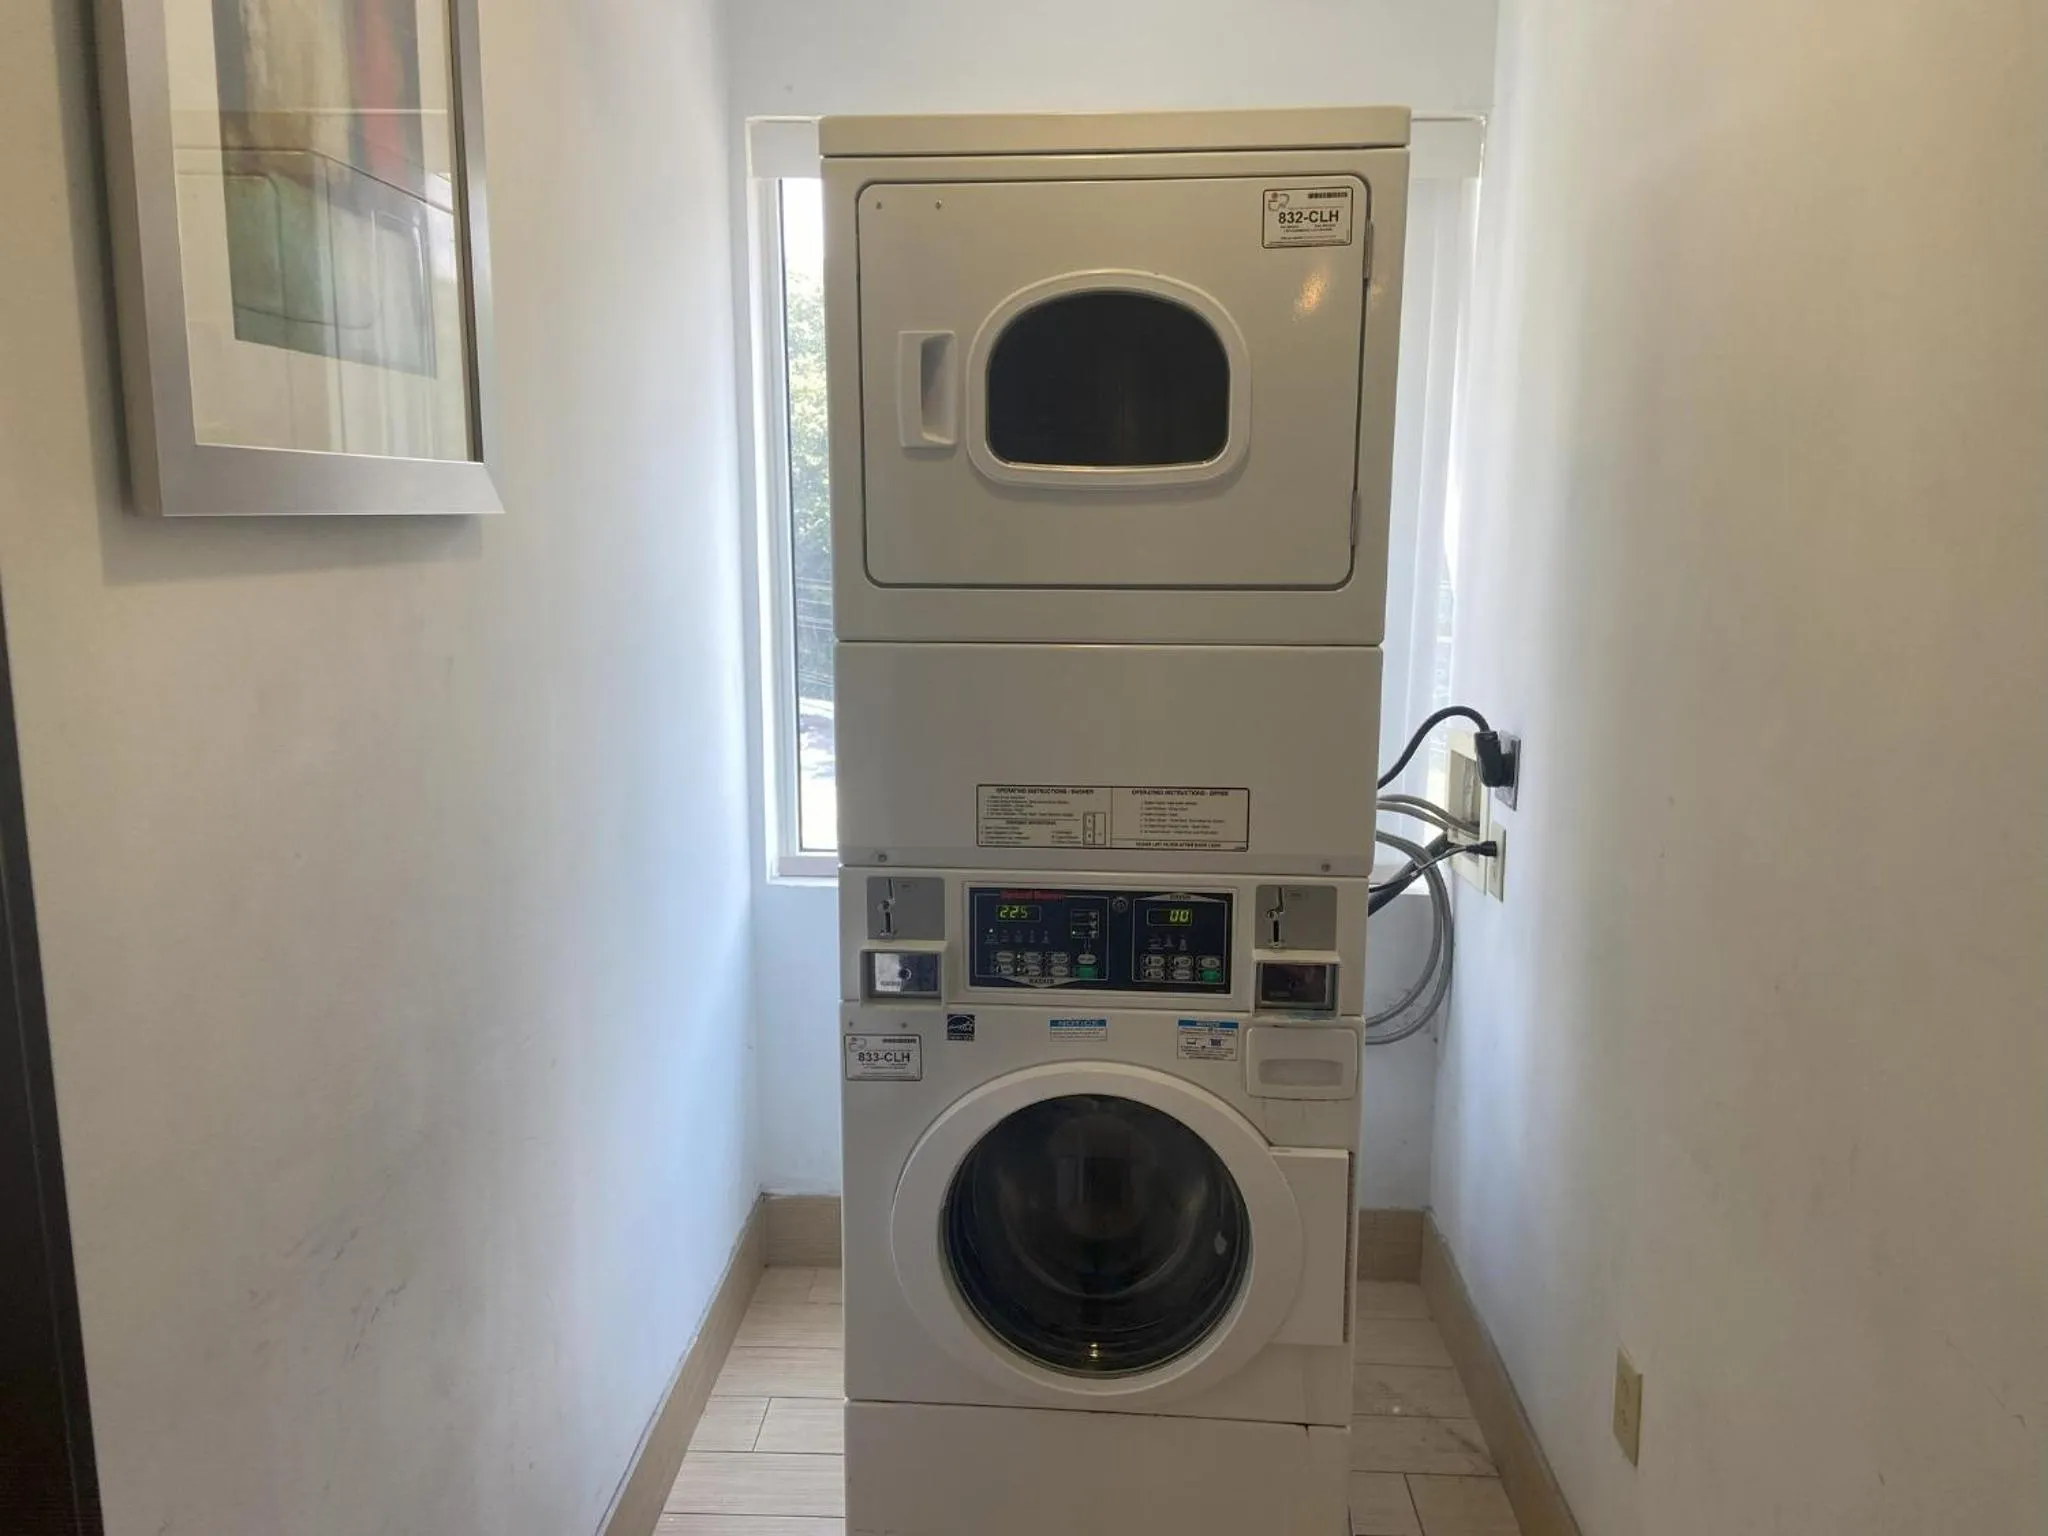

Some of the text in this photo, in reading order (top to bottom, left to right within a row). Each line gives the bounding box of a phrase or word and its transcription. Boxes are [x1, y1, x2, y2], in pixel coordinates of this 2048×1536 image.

[1278, 210, 1339, 224] 832-CLH
[1000, 906, 1028, 919] 225
[858, 1052, 911, 1062] 833-CLH
